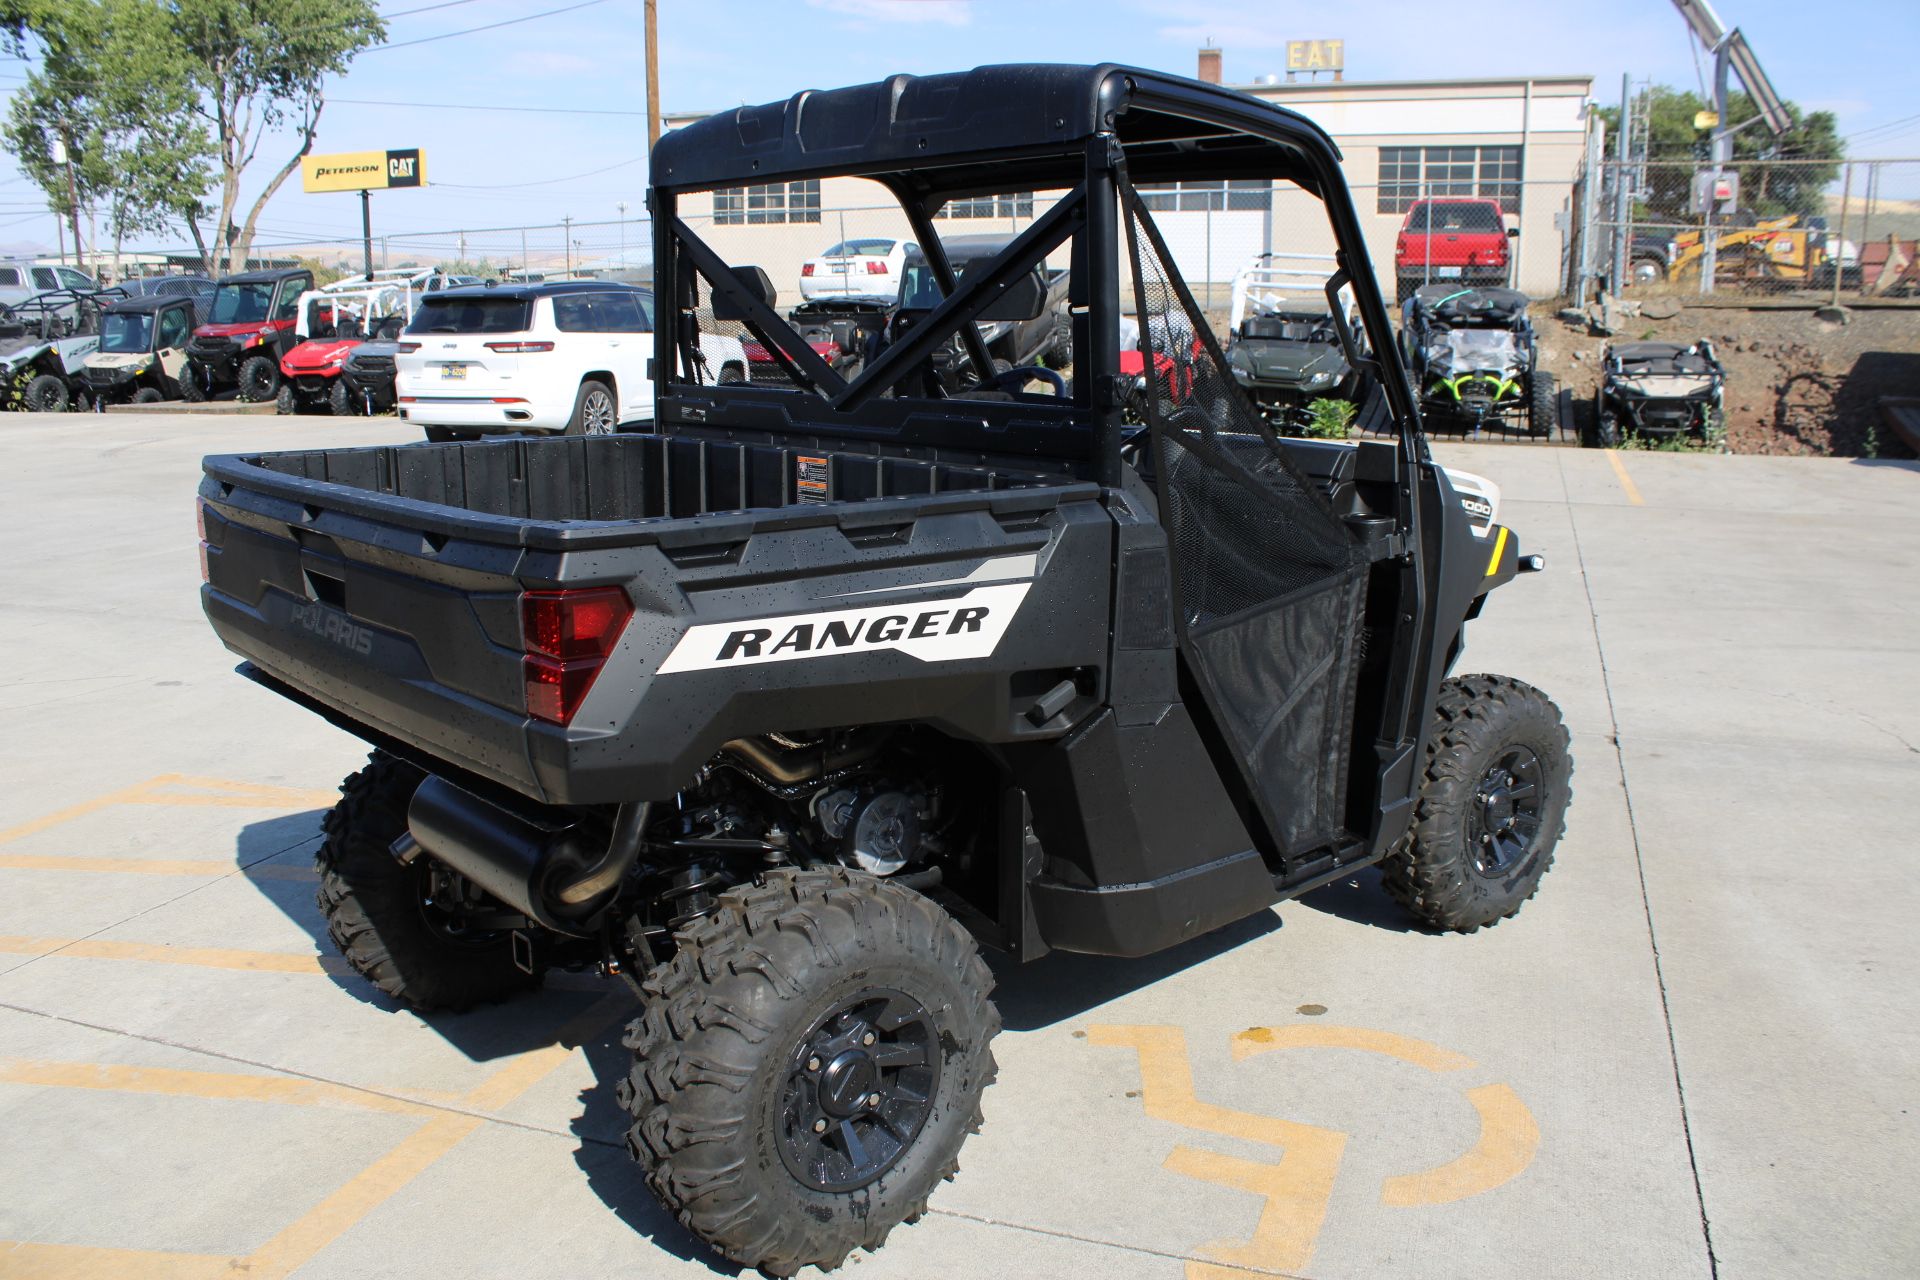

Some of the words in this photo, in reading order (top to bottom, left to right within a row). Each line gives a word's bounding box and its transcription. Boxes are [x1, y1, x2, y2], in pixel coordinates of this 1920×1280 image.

[1288, 41, 1342, 67] EAT
[315, 165, 379, 179] PETERSON
[389, 158, 415, 177] CAT
[442, 342, 458, 350] Jeep
[1461, 499, 1491, 515] 1000
[290, 603, 374, 655] POLARIS
[715, 606, 990, 661] RANGER
